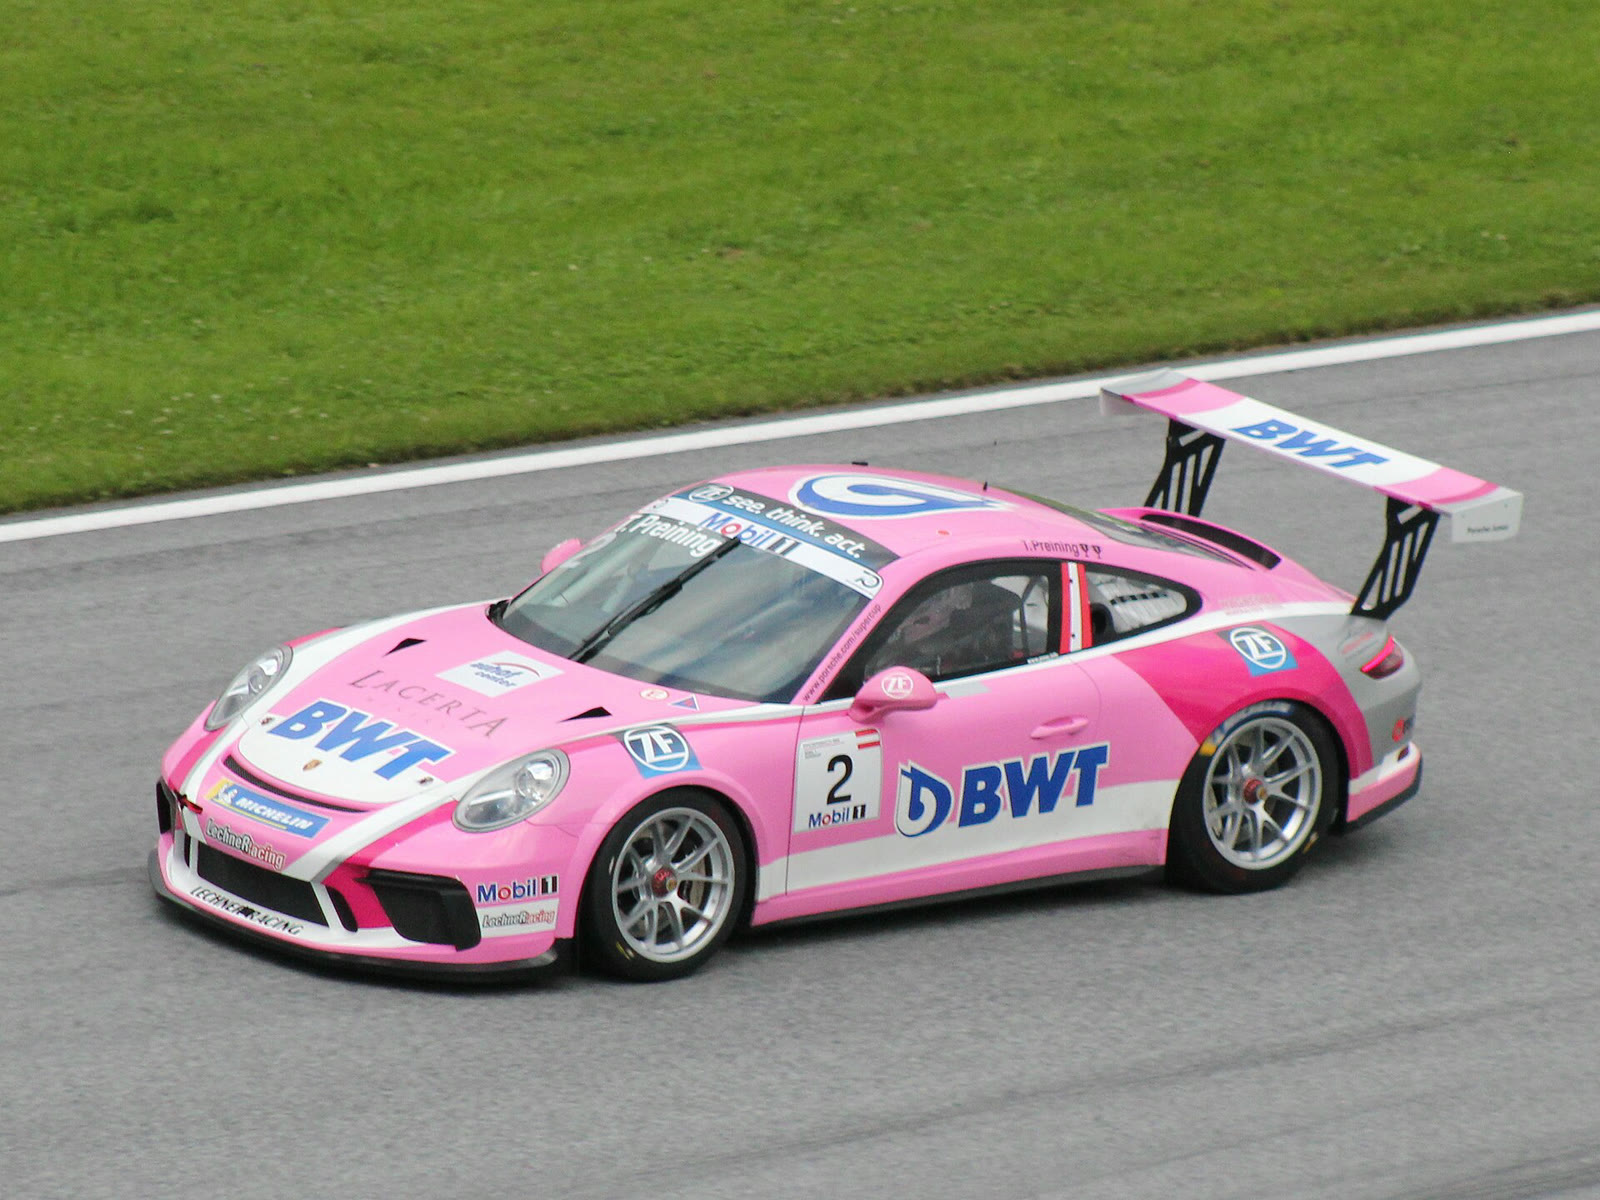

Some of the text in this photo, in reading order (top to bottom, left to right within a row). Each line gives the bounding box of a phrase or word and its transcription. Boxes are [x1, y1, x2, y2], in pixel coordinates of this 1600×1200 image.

[1228, 418, 1391, 469] BWT
[700, 512, 775, 550] Mobil
[721, 495, 767, 515] see.
[765, 507, 827, 538] think.
[824, 532, 866, 559] act.
[1232, 632, 1285, 660] ZF
[348, 669, 510, 737] LACERTA
[266, 700, 452, 781] BWT
[626, 730, 688, 763] ZF
[826, 754, 853, 806] 2
[957, 743, 1109, 828] BWT
[235, 796, 314, 830] MICHELIN
[808, 804, 867, 829] Mobil 1
[477, 875, 558, 902] Mobil 1
